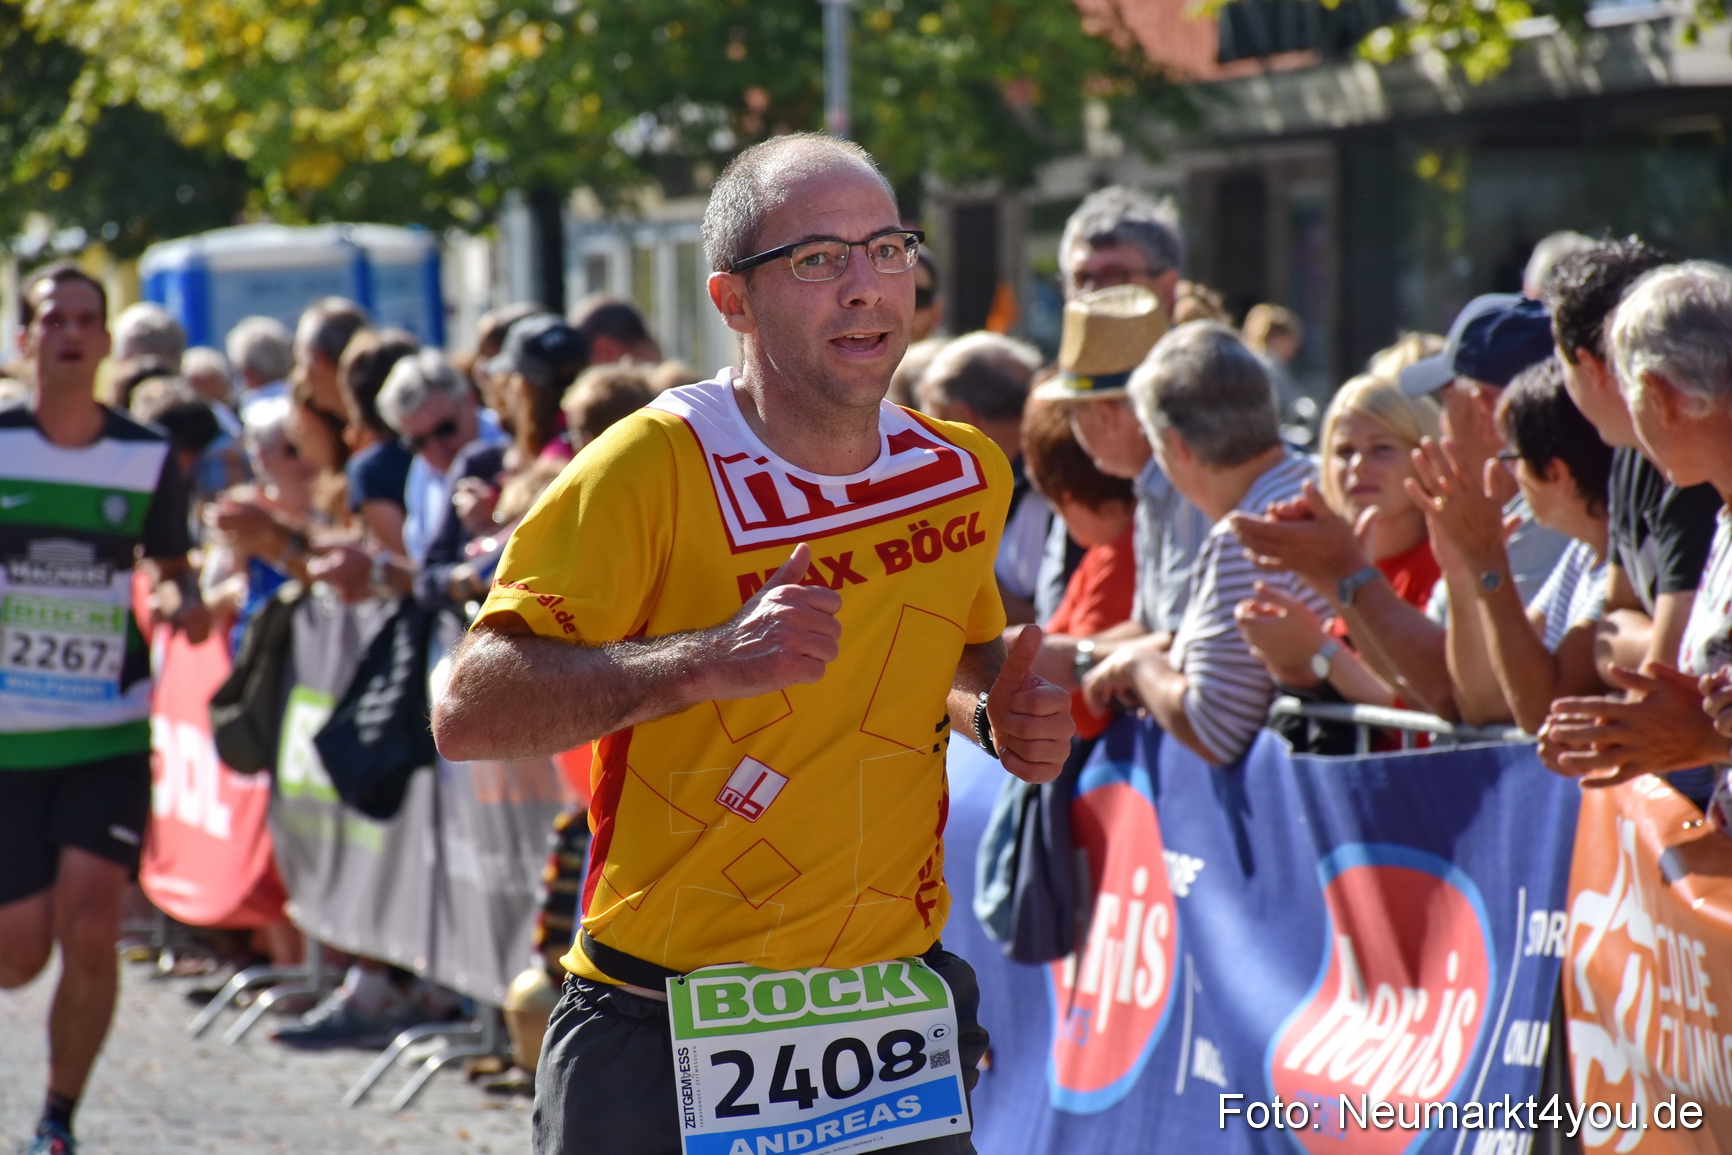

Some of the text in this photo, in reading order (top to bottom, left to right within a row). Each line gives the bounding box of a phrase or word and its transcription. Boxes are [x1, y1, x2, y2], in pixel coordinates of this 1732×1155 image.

[874, 511, 986, 576] BÖGL
[12, 632, 108, 671] 2267
[694, 961, 921, 1024] BOCK
[1656, 923, 1718, 1017] CODE
[933, 1028, 945, 1038] C
[710, 1029, 927, 1118] 2408
[727, 1094, 922, 1155] ANDREAS
